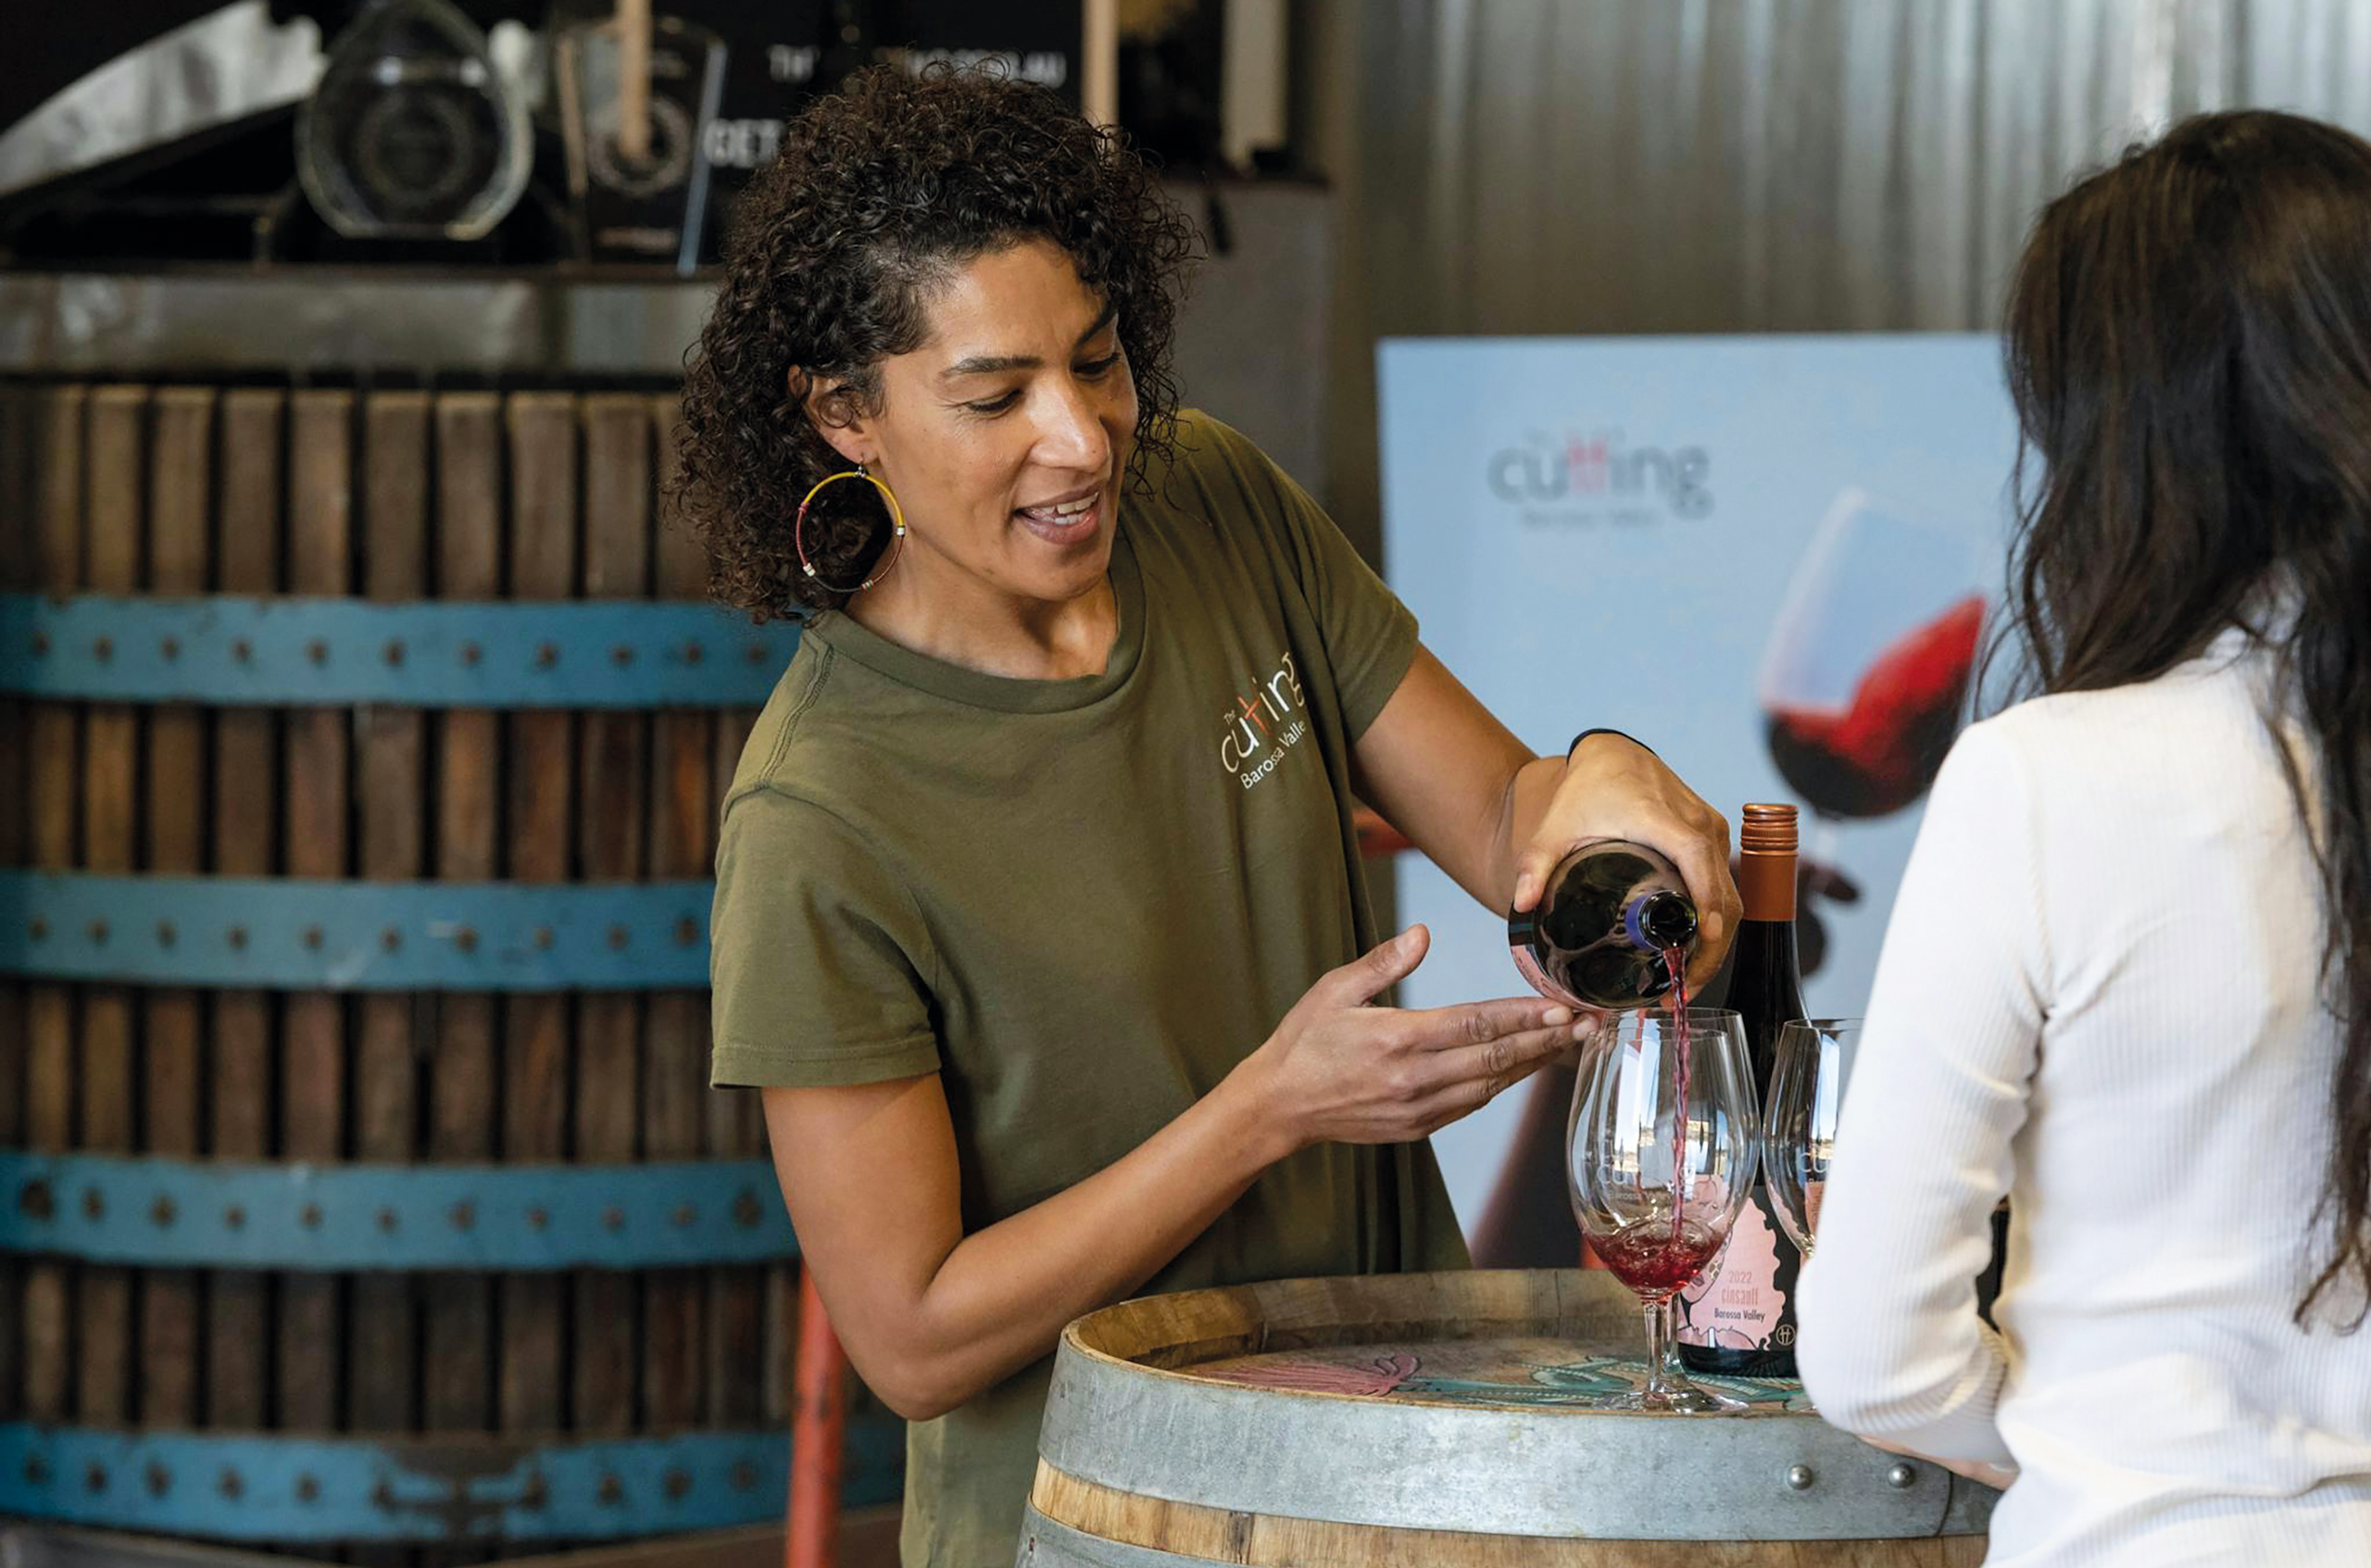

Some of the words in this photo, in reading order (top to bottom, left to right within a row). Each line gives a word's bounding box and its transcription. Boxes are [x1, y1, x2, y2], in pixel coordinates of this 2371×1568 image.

[1278, 721, 1306, 747] Valle
[1729, 1271, 1752, 1284] 2022
[1714, 1308, 1741, 1320] Barossa
[1743, 1310, 1765, 1323] Valley
